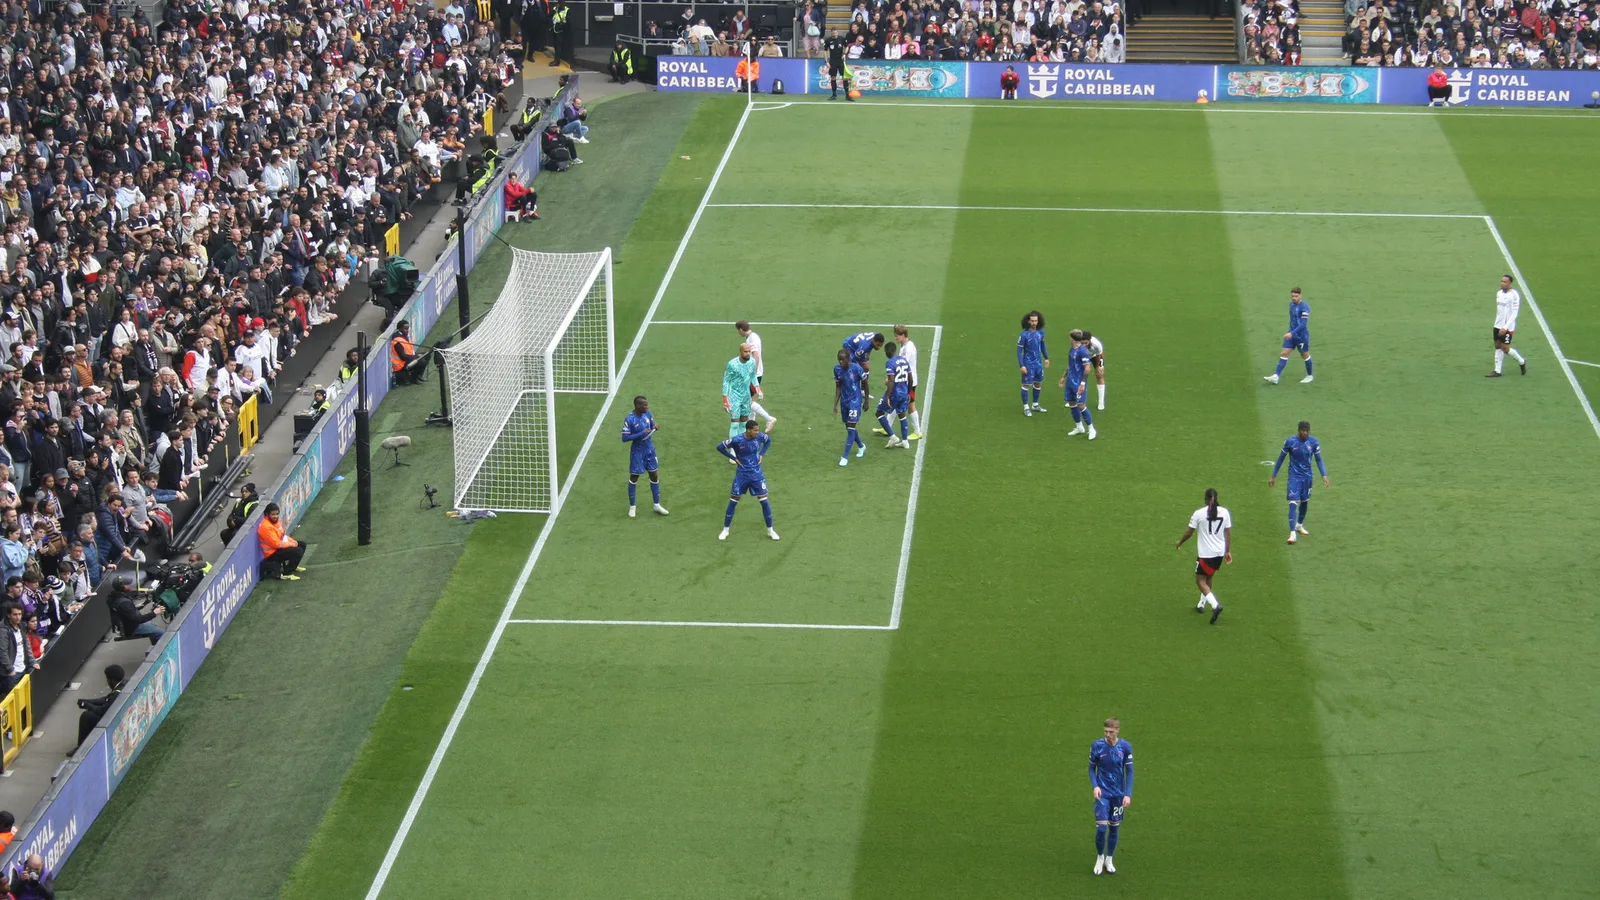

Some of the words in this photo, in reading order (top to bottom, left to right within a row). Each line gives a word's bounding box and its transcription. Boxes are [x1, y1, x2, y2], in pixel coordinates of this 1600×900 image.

[659, 61, 708, 73] ROYAL
[1064, 68, 1115, 81] ROYAL
[1478, 74, 1529, 86] ROYAL
[1064, 83, 1155, 96] CARIBBEAN
[1477, 89, 1570, 102] CARIBBEAN
[894, 364, 909, 383] 25
[848, 409, 858, 418] 23
[1206, 516, 1225, 535] 17
[216, 563, 237, 603] ROYAL
[217, 564, 252, 627] CARIBBEAN
[1112, 806, 1124, 816] 20
[44, 814, 77, 871] IBBEAN
